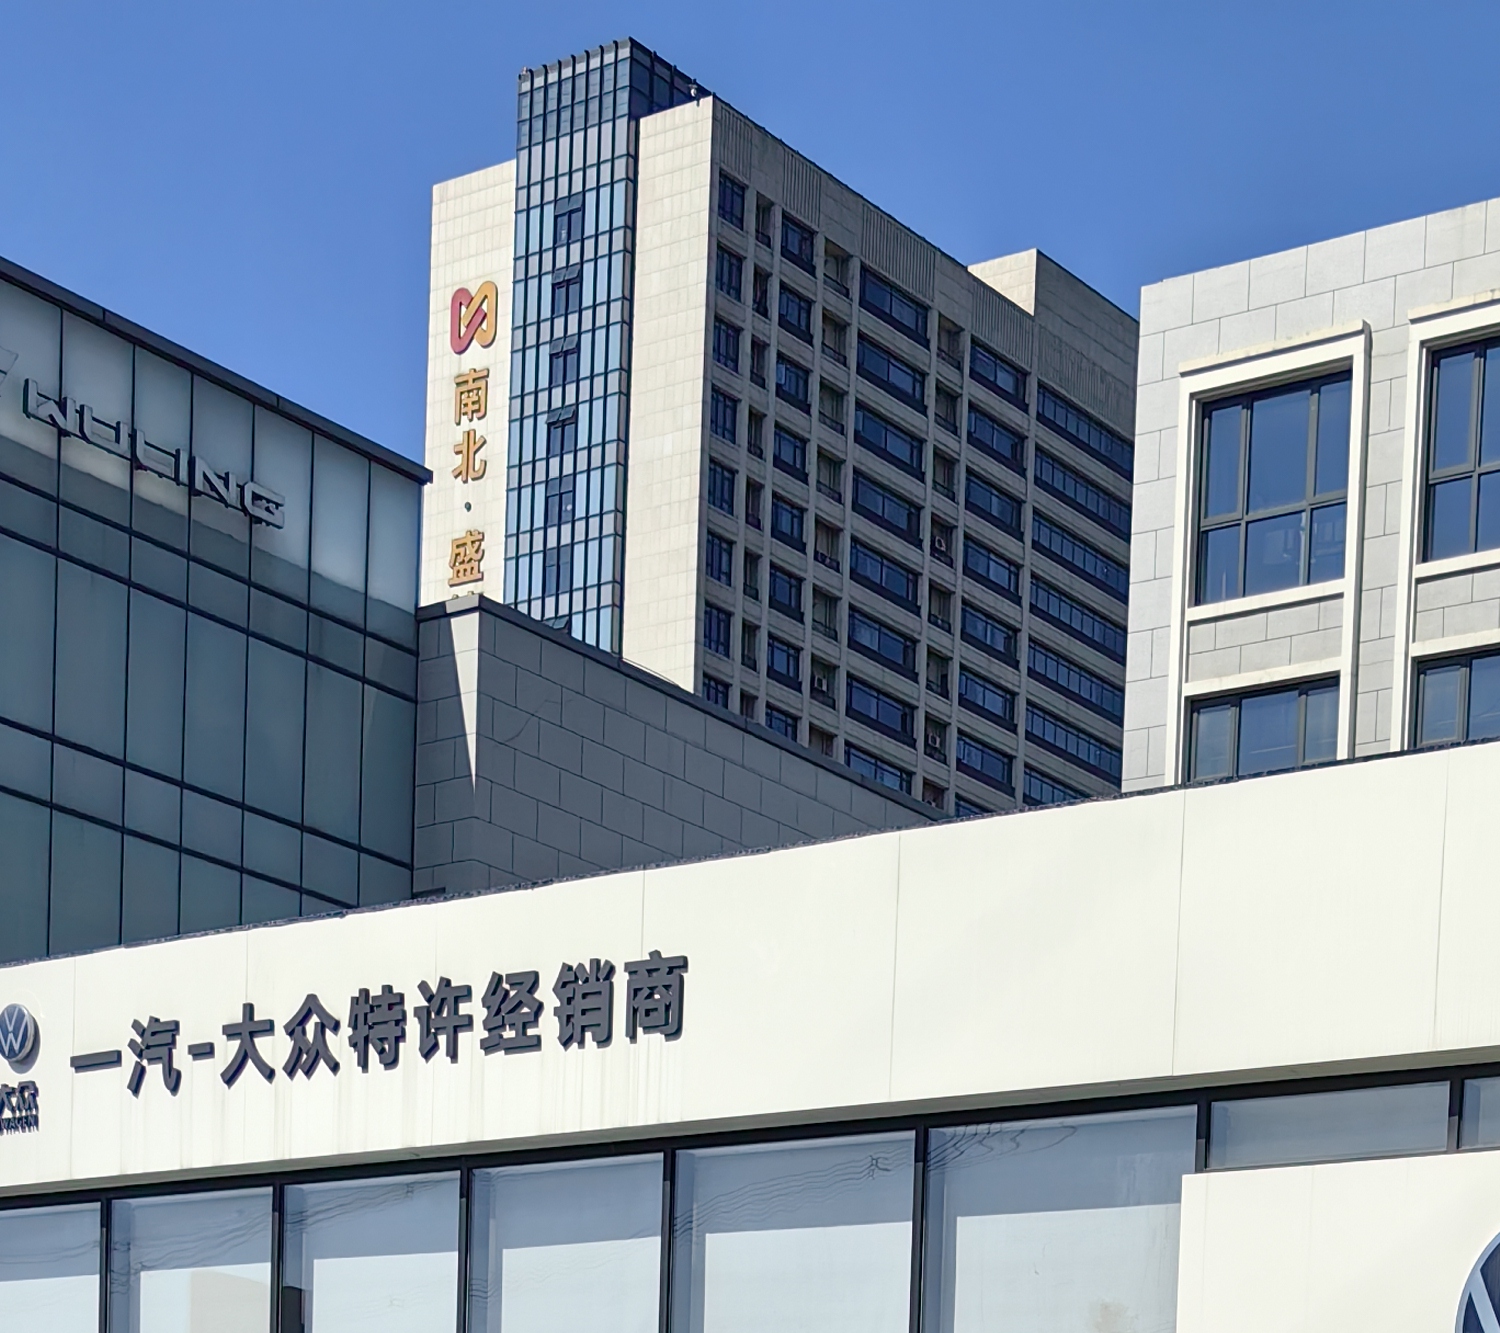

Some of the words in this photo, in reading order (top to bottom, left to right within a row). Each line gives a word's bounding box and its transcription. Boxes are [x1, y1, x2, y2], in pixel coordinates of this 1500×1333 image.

[23, 378, 285, 529] WULING
[448, 368, 490, 597] 南北·盛
